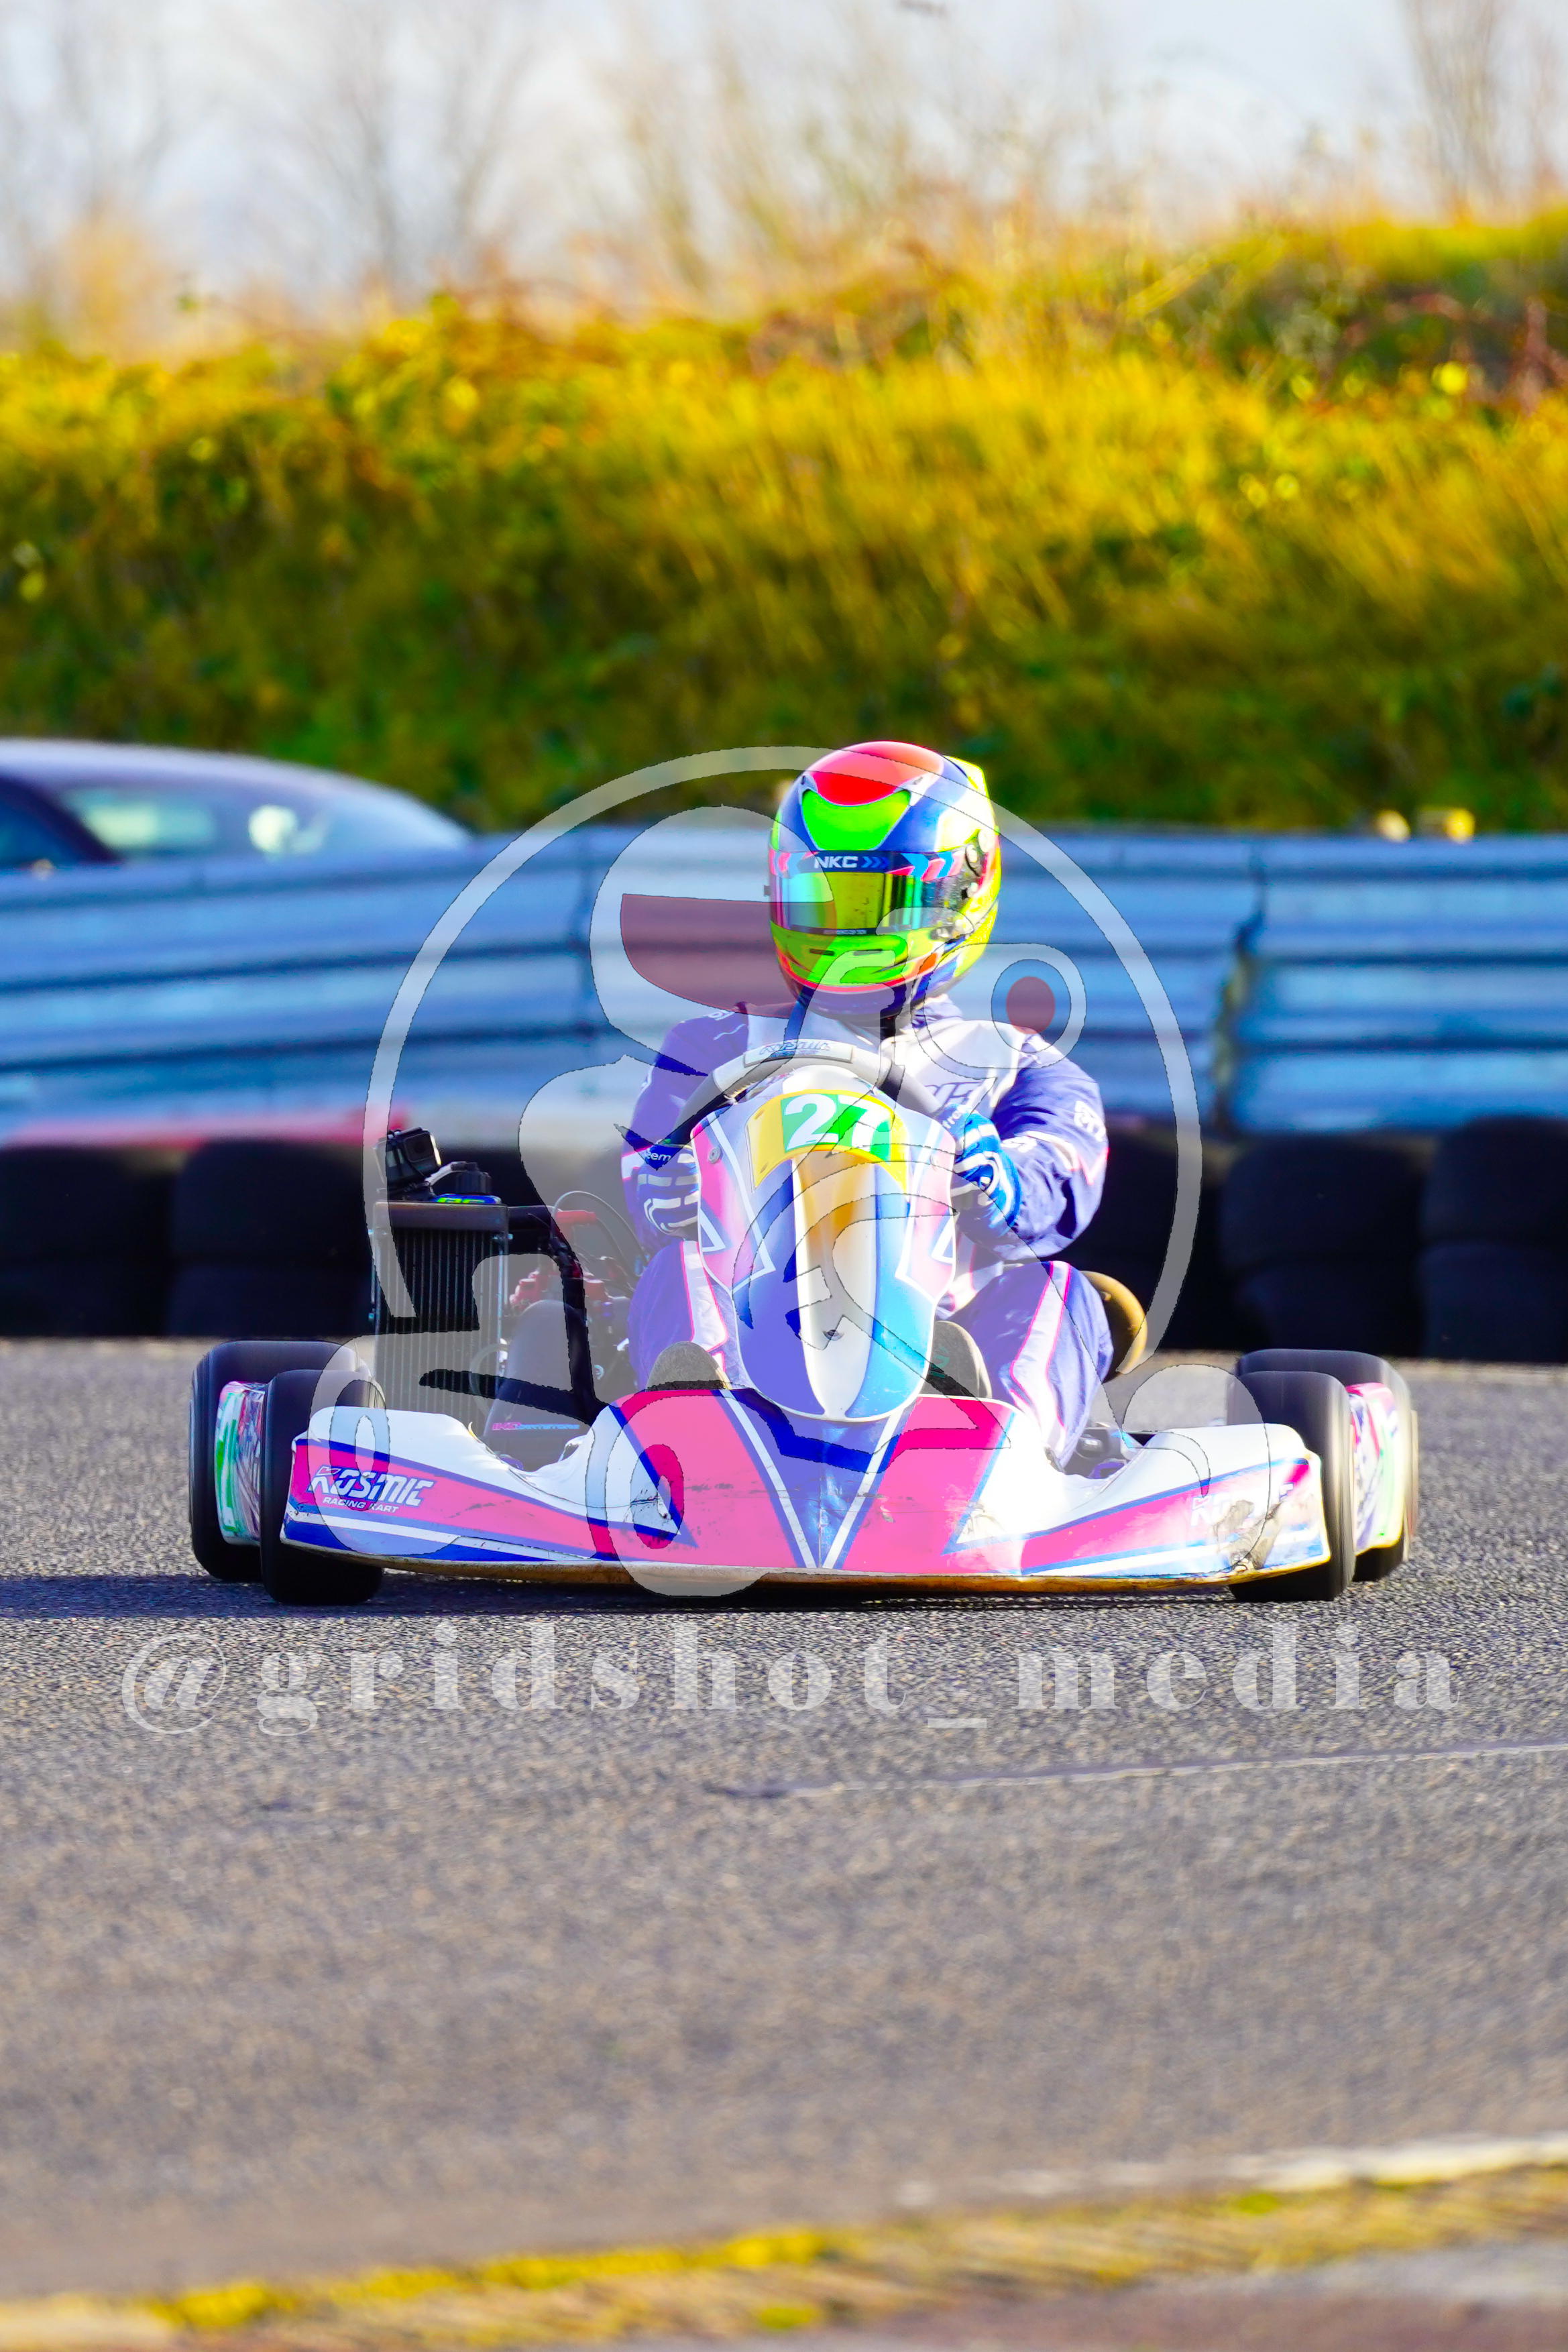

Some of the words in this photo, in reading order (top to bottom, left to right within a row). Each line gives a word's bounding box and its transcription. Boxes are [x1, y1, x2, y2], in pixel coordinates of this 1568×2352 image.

[814, 856, 858, 869] NKC
[784, 1093, 891, 1154] 27
[307, 1465, 435, 1507] KOSMIC
[322, 1496, 367, 1509] RACING
[368, 1503, 399, 1513] KART
